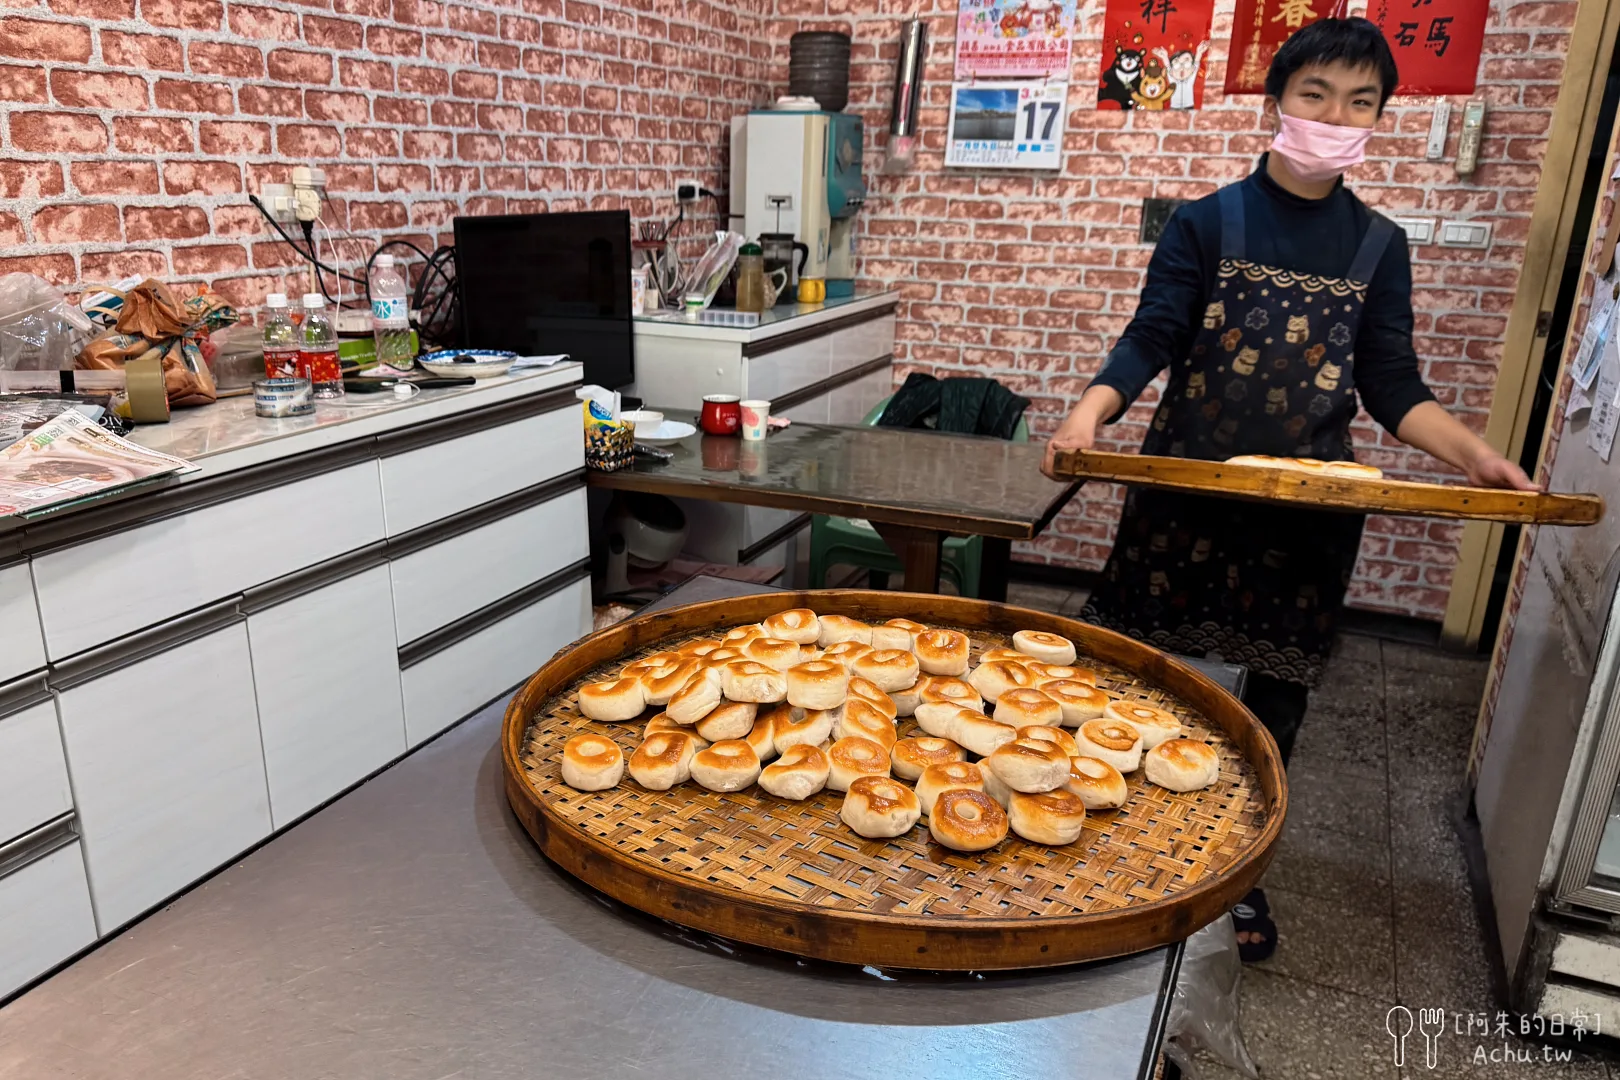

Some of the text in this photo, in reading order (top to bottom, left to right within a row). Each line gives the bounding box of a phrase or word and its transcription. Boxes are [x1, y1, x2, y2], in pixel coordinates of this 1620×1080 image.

[1140, 0, 1177, 34] 祥
[1020, 87, 1030, 99] 3
[1022, 101, 1061, 141] 17
